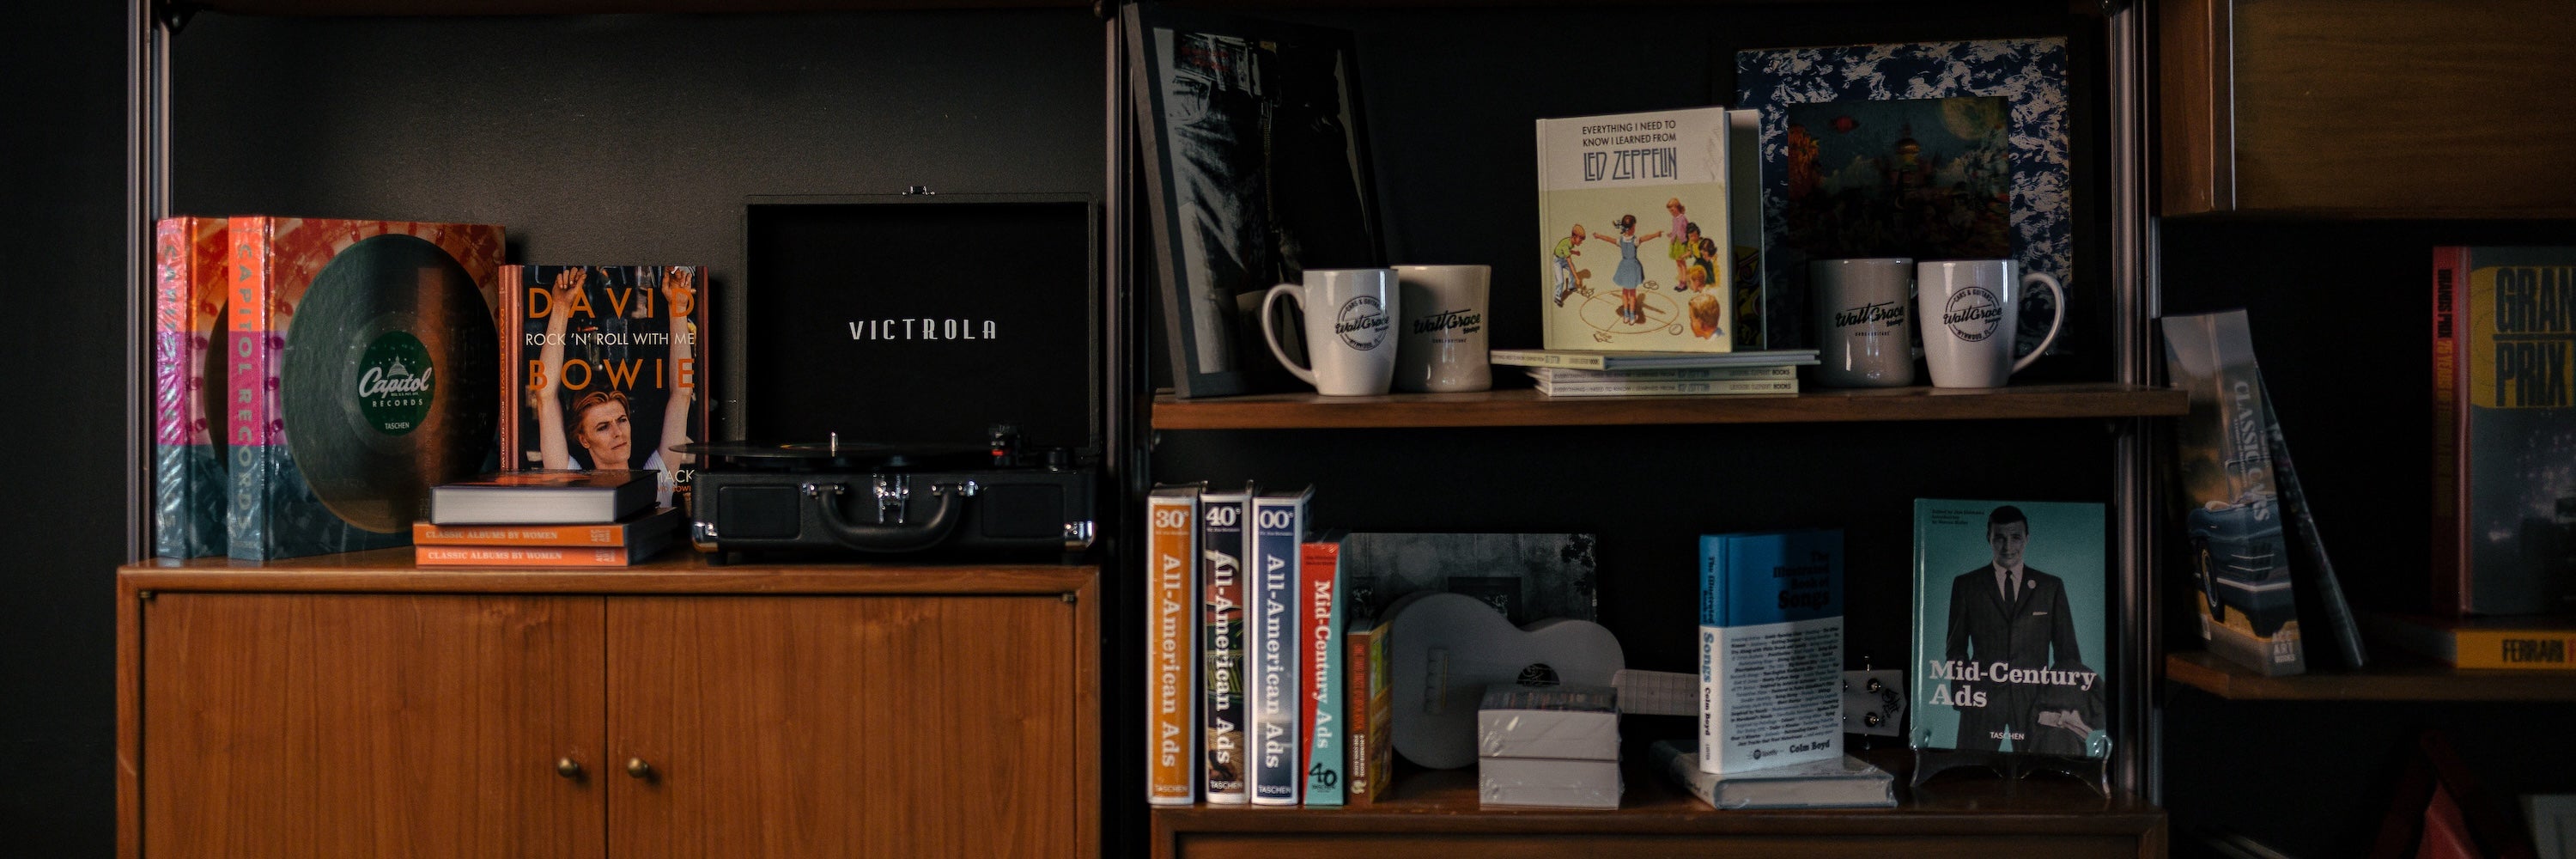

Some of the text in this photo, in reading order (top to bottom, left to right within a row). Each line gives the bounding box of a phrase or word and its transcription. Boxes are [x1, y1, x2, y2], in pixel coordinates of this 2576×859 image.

[1583, 119, 1676, 135] EVERYTHING I NEED TO
[1583, 137, 1609, 147] KNOW
[1616, 134, 1651, 145] LEARNED
[1653, 133, 1677, 143] FROM
[1583, 147, 1678, 181] LED ZEPPELIN
[237, 243, 253, 375] CAPITOL
[528, 287, 696, 320] DAVID
[526, 333, 567, 346] ROCK
[597, 333, 629, 345] ROLL
[633, 333, 669, 345] WITH
[674, 333, 696, 345] ME
[848, 318, 997, 340] VICTROLA
[359, 367, 432, 399] Capitol
[529, 358, 696, 391] BOWIE
[2495, 343, 2567, 407] PRIX
[373, 399, 423, 408] RECORDS
[425, 531, 465, 539] CLASSIC
[466, 531, 506, 539] ALBUMS
[428, 551, 468, 560] CLASSIC
[471, 551, 509, 560] ALBUMS
[1778, 590, 1830, 611] Songs
[1163, 553, 1182, 715] All-American
[1215, 549, 1234, 711] All-American
[1267, 553, 1285, 715] All-American
[1311, 580, 1332, 704] Mid-Century
[1703, 632, 1714, 683] Songs
[2502, 639, 2564, 663] FERRARI
[1929, 660, 2098, 691] Mid-Century
[1929, 685, 1988, 708] Ads
[1162, 722, 1181, 767] Ads
[1216, 716, 1235, 765] Ads
[1316, 709, 1333, 749] Ads
[1990, 731, 2025, 740] TASCHEN
[1265, 722, 1284, 769] Ads
[1789, 743, 1809, 753] Colm
[1811, 740, 1831, 751] Boyd
[1210, 780, 1243, 789] TASCHEN
[1258, 785, 1291, 794] TASCHEN
